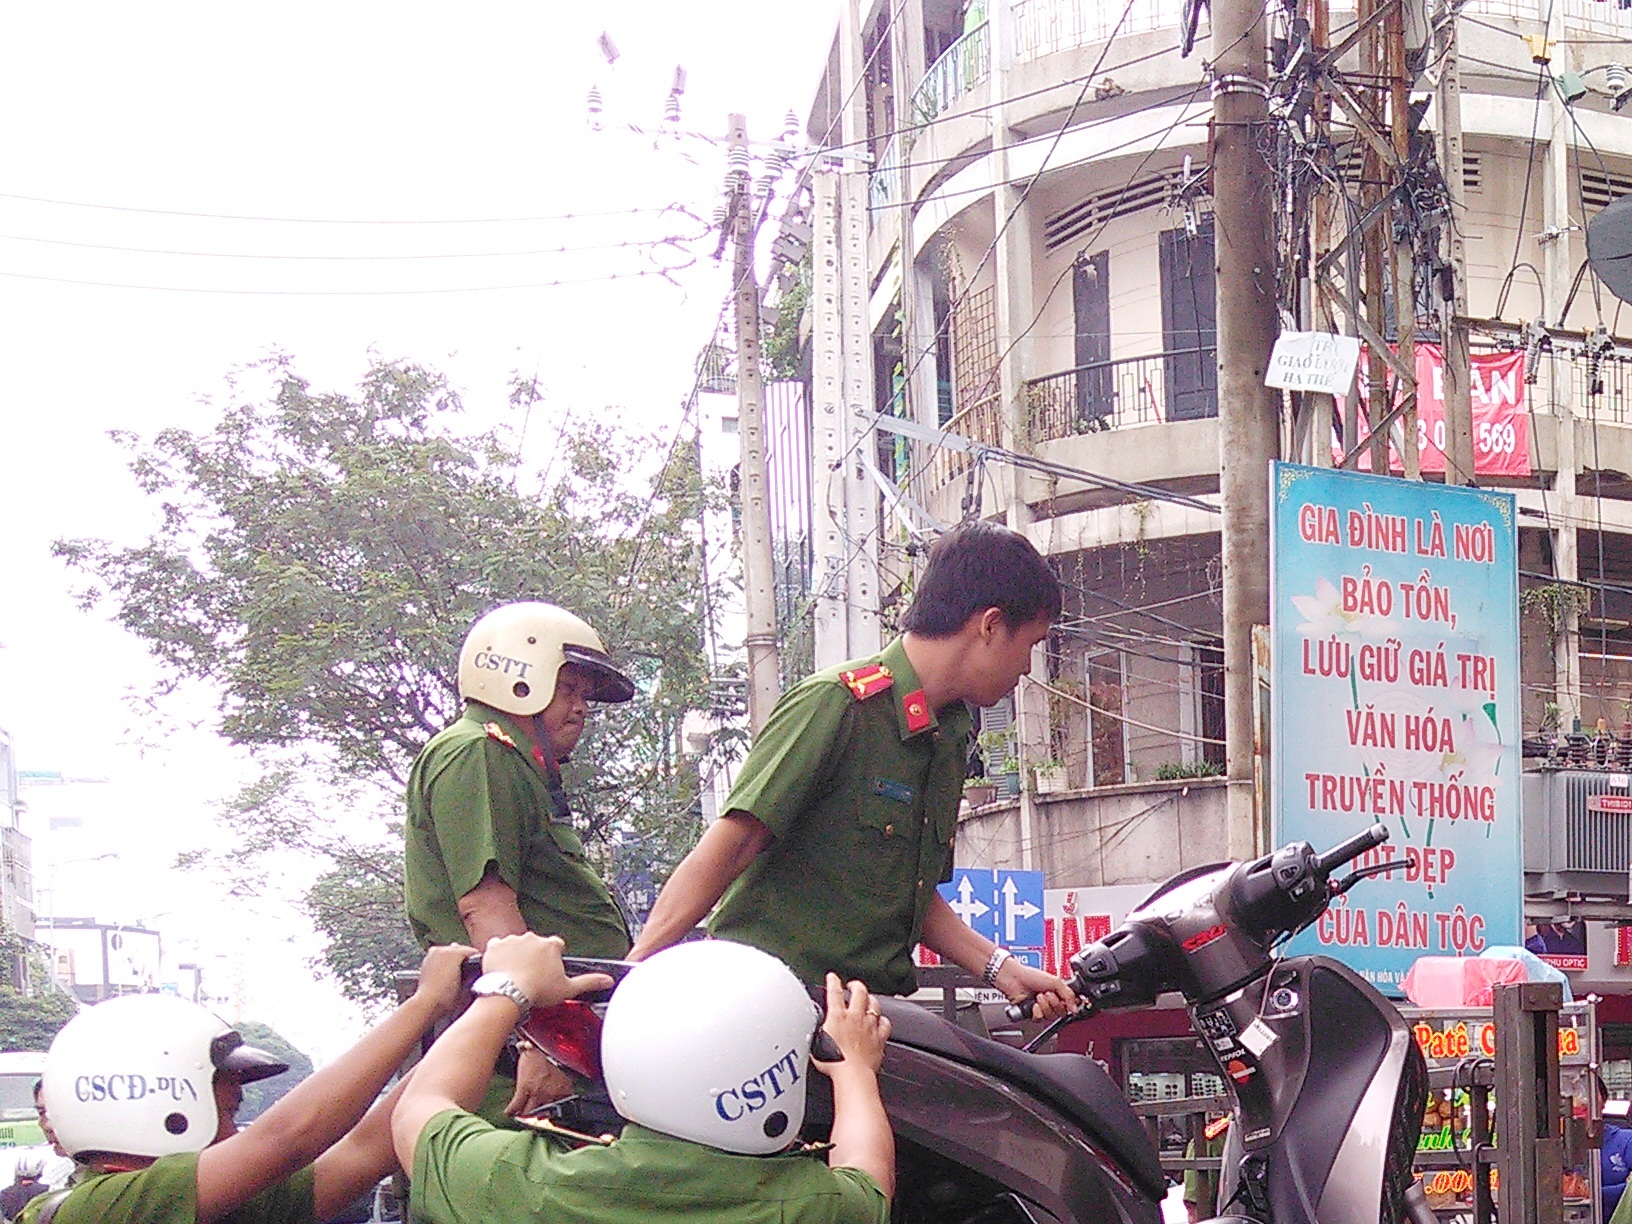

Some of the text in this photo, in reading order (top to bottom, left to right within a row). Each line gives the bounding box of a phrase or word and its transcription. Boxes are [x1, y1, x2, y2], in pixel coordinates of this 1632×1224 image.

[1479, 421, 1516, 454] 569
[1300, 504, 1494, 562] GIA ĐÌNH LÀ NƠI
[1342, 565, 1457, 630] BẢO TỒN,
[474, 651, 533, 679] CSTT
[1303, 634, 1496, 700] LƯU GIỮ GIÁ TRỊ
[1346, 703, 1454, 753] VĂN HÓA
[1305, 762, 1495, 822] TRUYỀN THỐNG
[1406, 847, 1454, 890] ĐẸP
[1318, 895, 1484, 957] CỦA DÂN TỘC
[1563, 958, 1585, 968] OPTIC
[1414, 1022, 1470, 1058] Patê
[716, 1048, 801, 1122] CSTT
